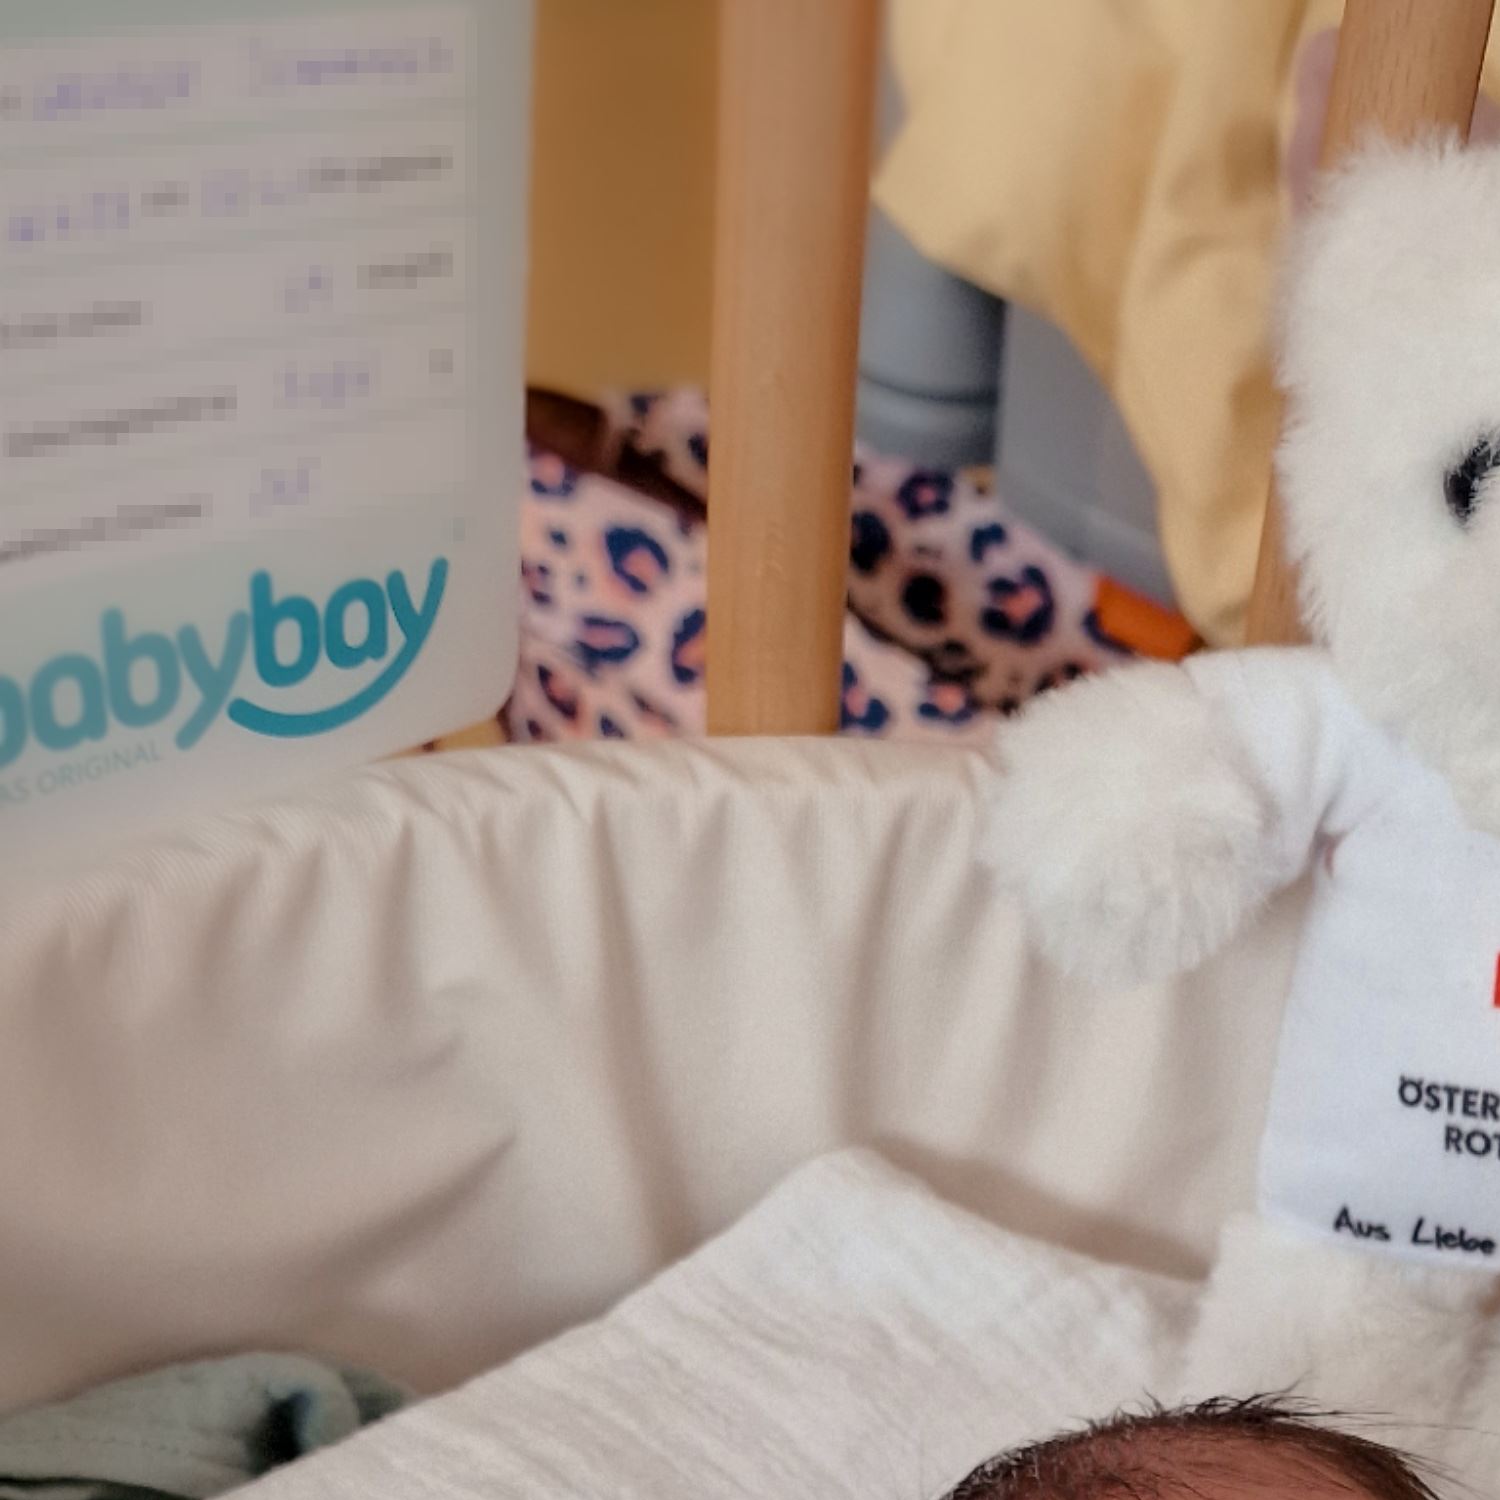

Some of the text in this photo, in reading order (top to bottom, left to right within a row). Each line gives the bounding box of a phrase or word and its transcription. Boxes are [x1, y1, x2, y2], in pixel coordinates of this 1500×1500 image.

[36, 739, 164, 795] ORIGINAL
[1333, 1204, 1392, 1242] Aus
[1411, 1217, 1496, 1256] Liebe
